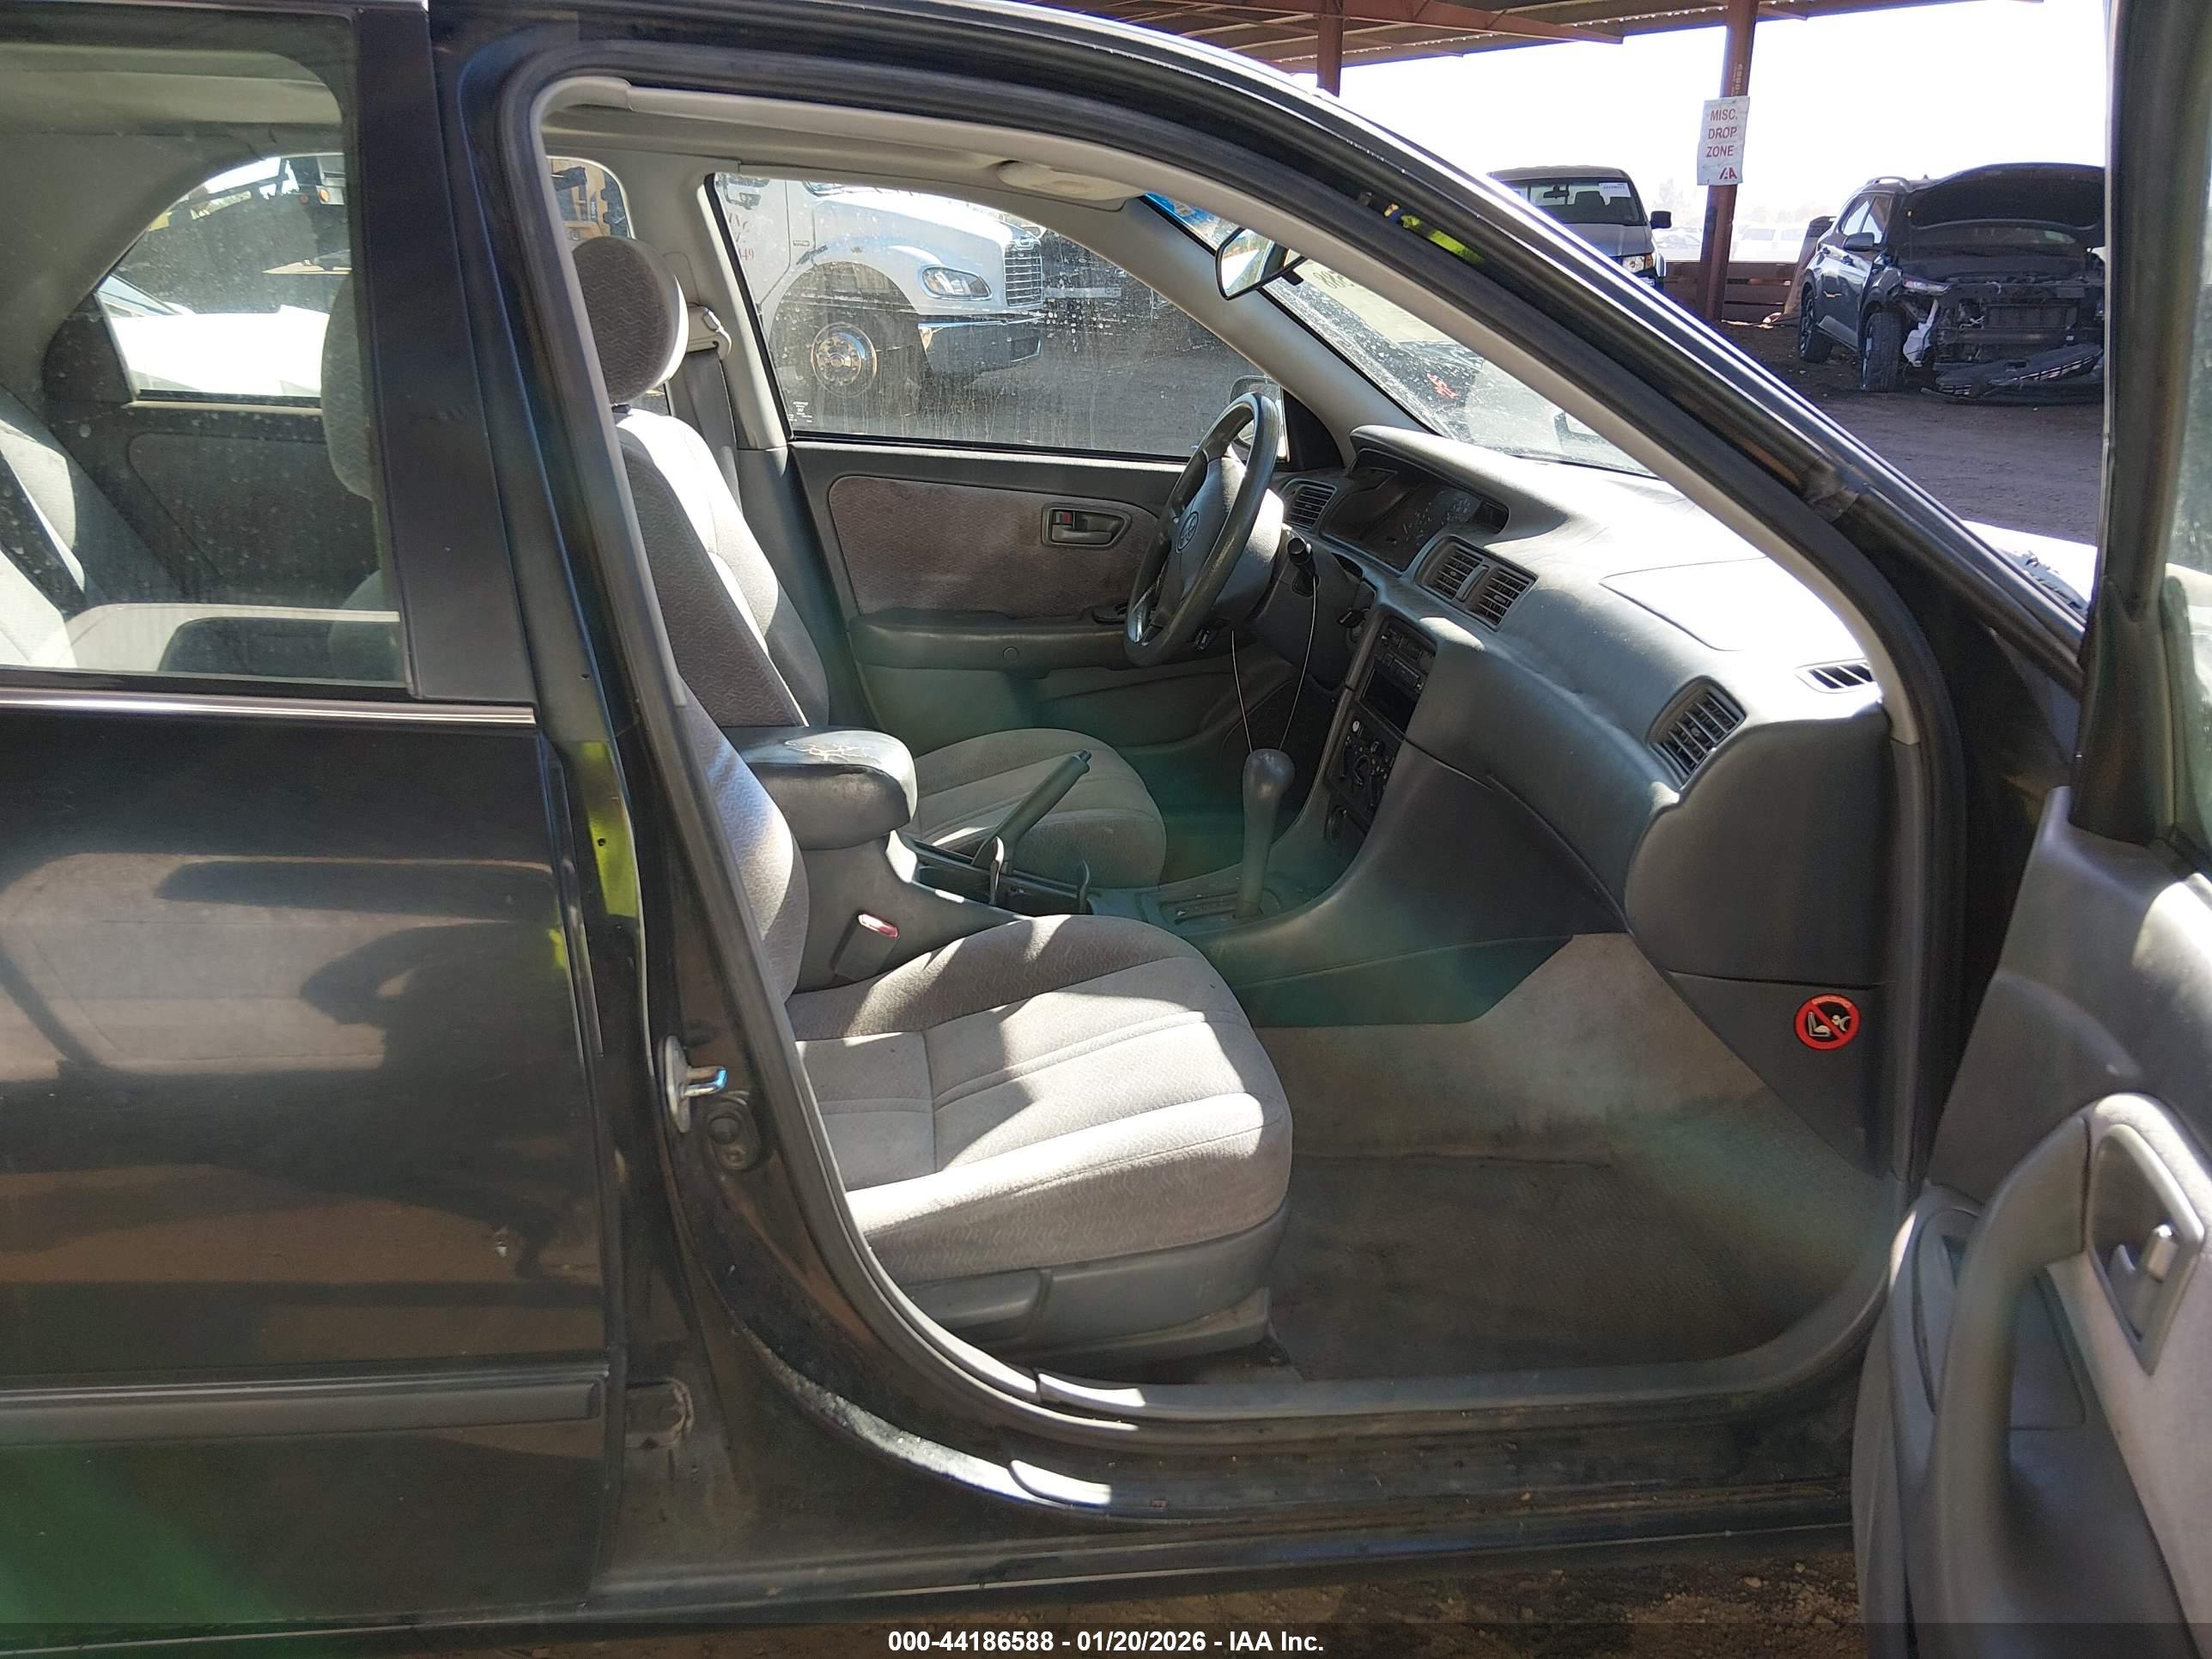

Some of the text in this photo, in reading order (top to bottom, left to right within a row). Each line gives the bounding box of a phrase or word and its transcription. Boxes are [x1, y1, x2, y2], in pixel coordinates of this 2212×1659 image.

[1711, 109, 1738, 121] MISC.
[1708, 127, 1737, 139] DROP
[1706, 145, 1734, 157] ZONE
